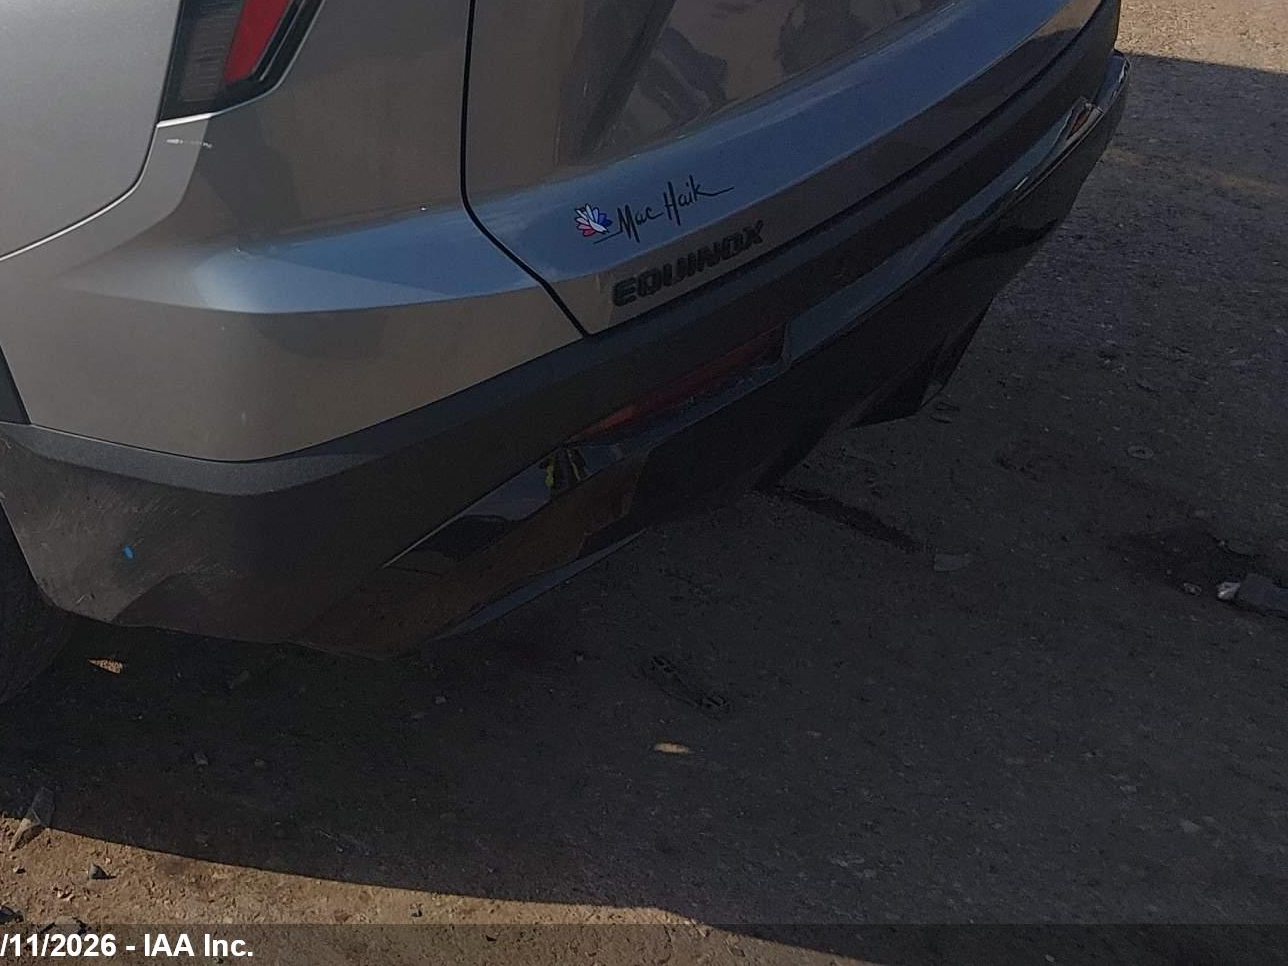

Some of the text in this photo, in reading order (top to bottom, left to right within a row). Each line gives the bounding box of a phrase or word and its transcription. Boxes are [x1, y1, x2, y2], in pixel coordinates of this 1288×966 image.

[594, 174, 734, 243] Mac Haik
[614, 220, 764, 306] EQUINOX
